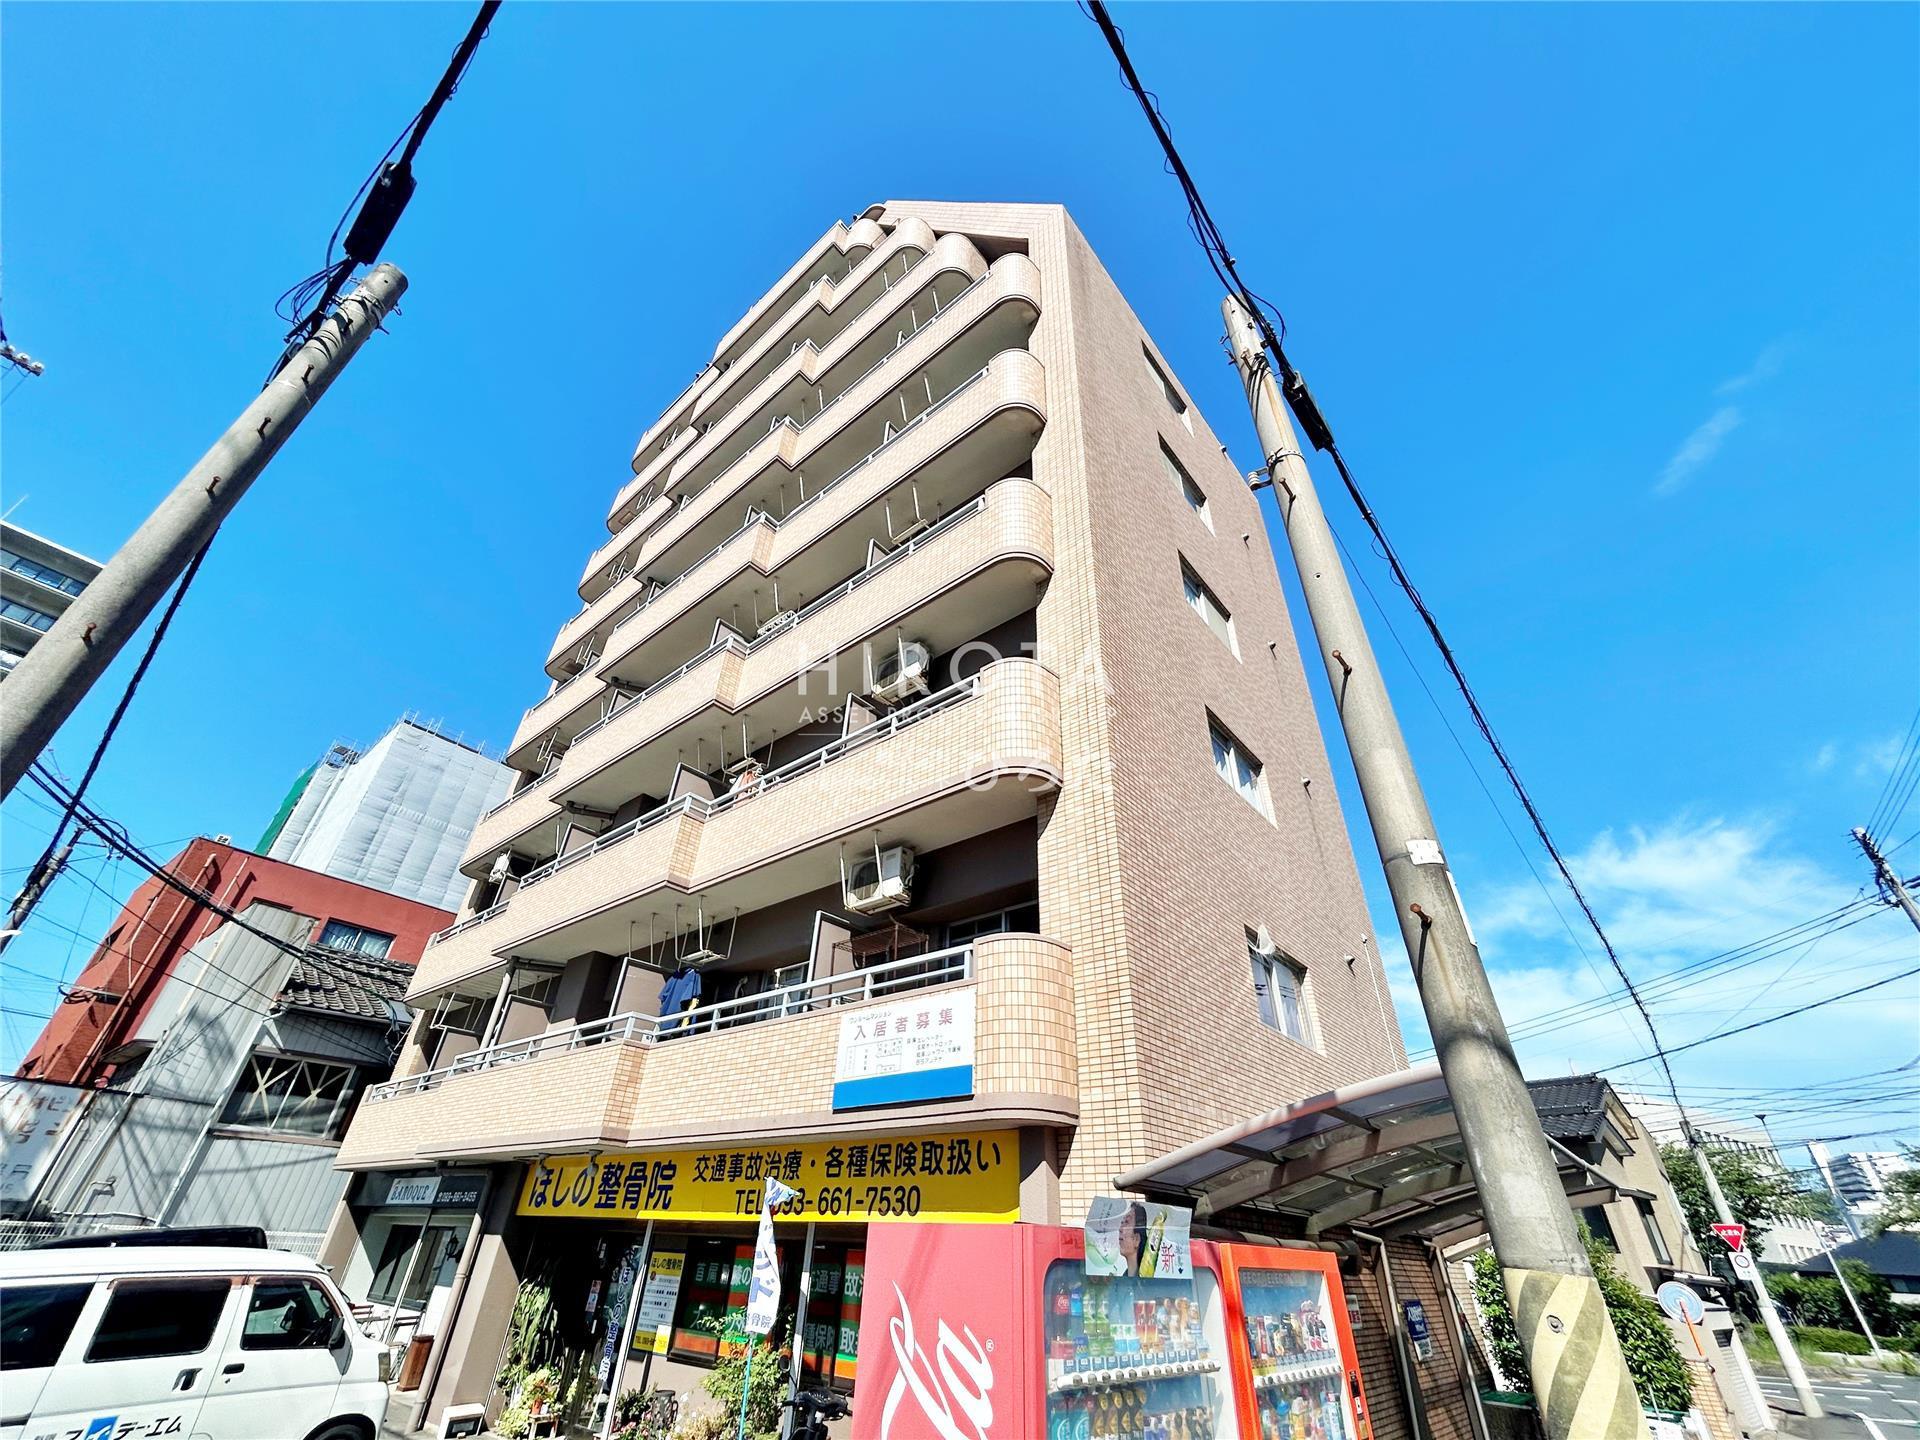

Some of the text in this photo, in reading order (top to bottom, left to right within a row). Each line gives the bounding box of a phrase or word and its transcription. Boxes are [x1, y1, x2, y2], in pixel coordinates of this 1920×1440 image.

[854, 1007, 953, 1041] 入居者募集
[692, 1138, 1001, 1182] 交通事故治療・各種保険取扱い
[529, 1160, 677, 1210] ほしの整骨院
[735, 1188, 764, 1216] TEL
[746, 1312, 772, 1329] 骨院
